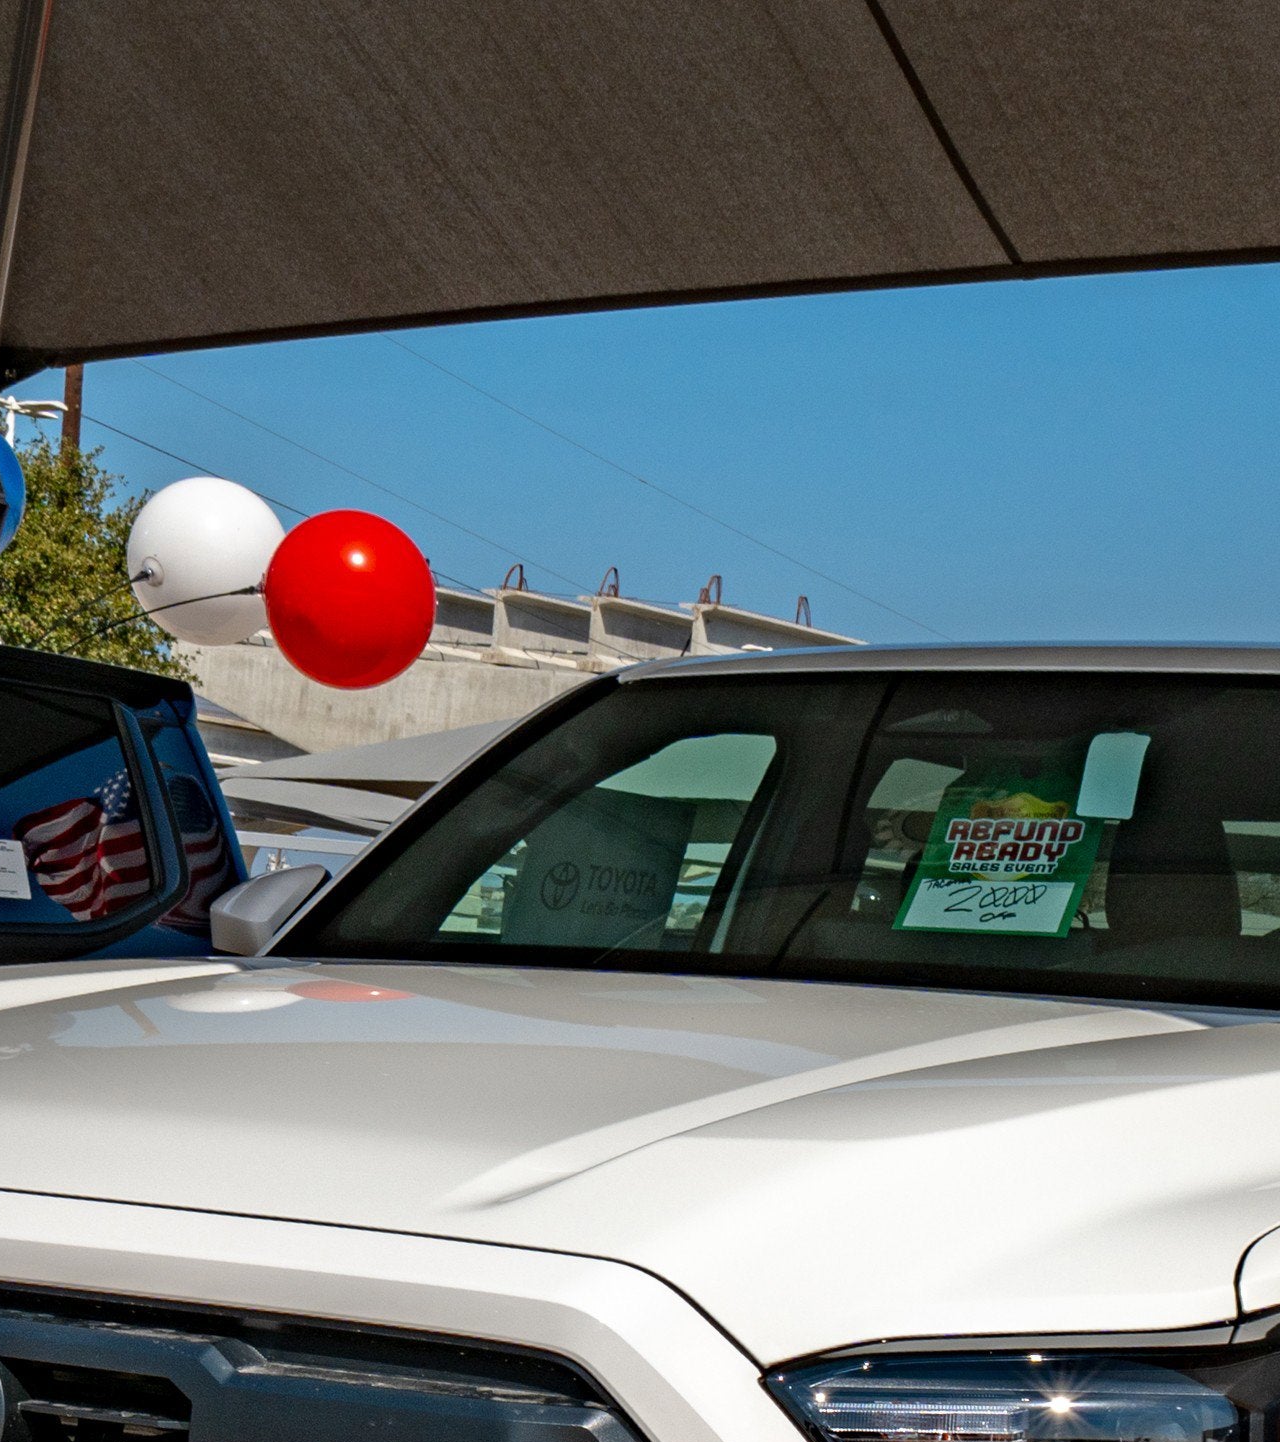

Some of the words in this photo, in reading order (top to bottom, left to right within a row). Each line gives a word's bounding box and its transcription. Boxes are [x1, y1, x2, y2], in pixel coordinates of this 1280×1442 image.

[948, 820, 1083, 842] REFUND
[953, 842, 1065, 862] READY
[950, 862, 999, 873] SALES
[1003, 863, 1057, 874] EVENT
